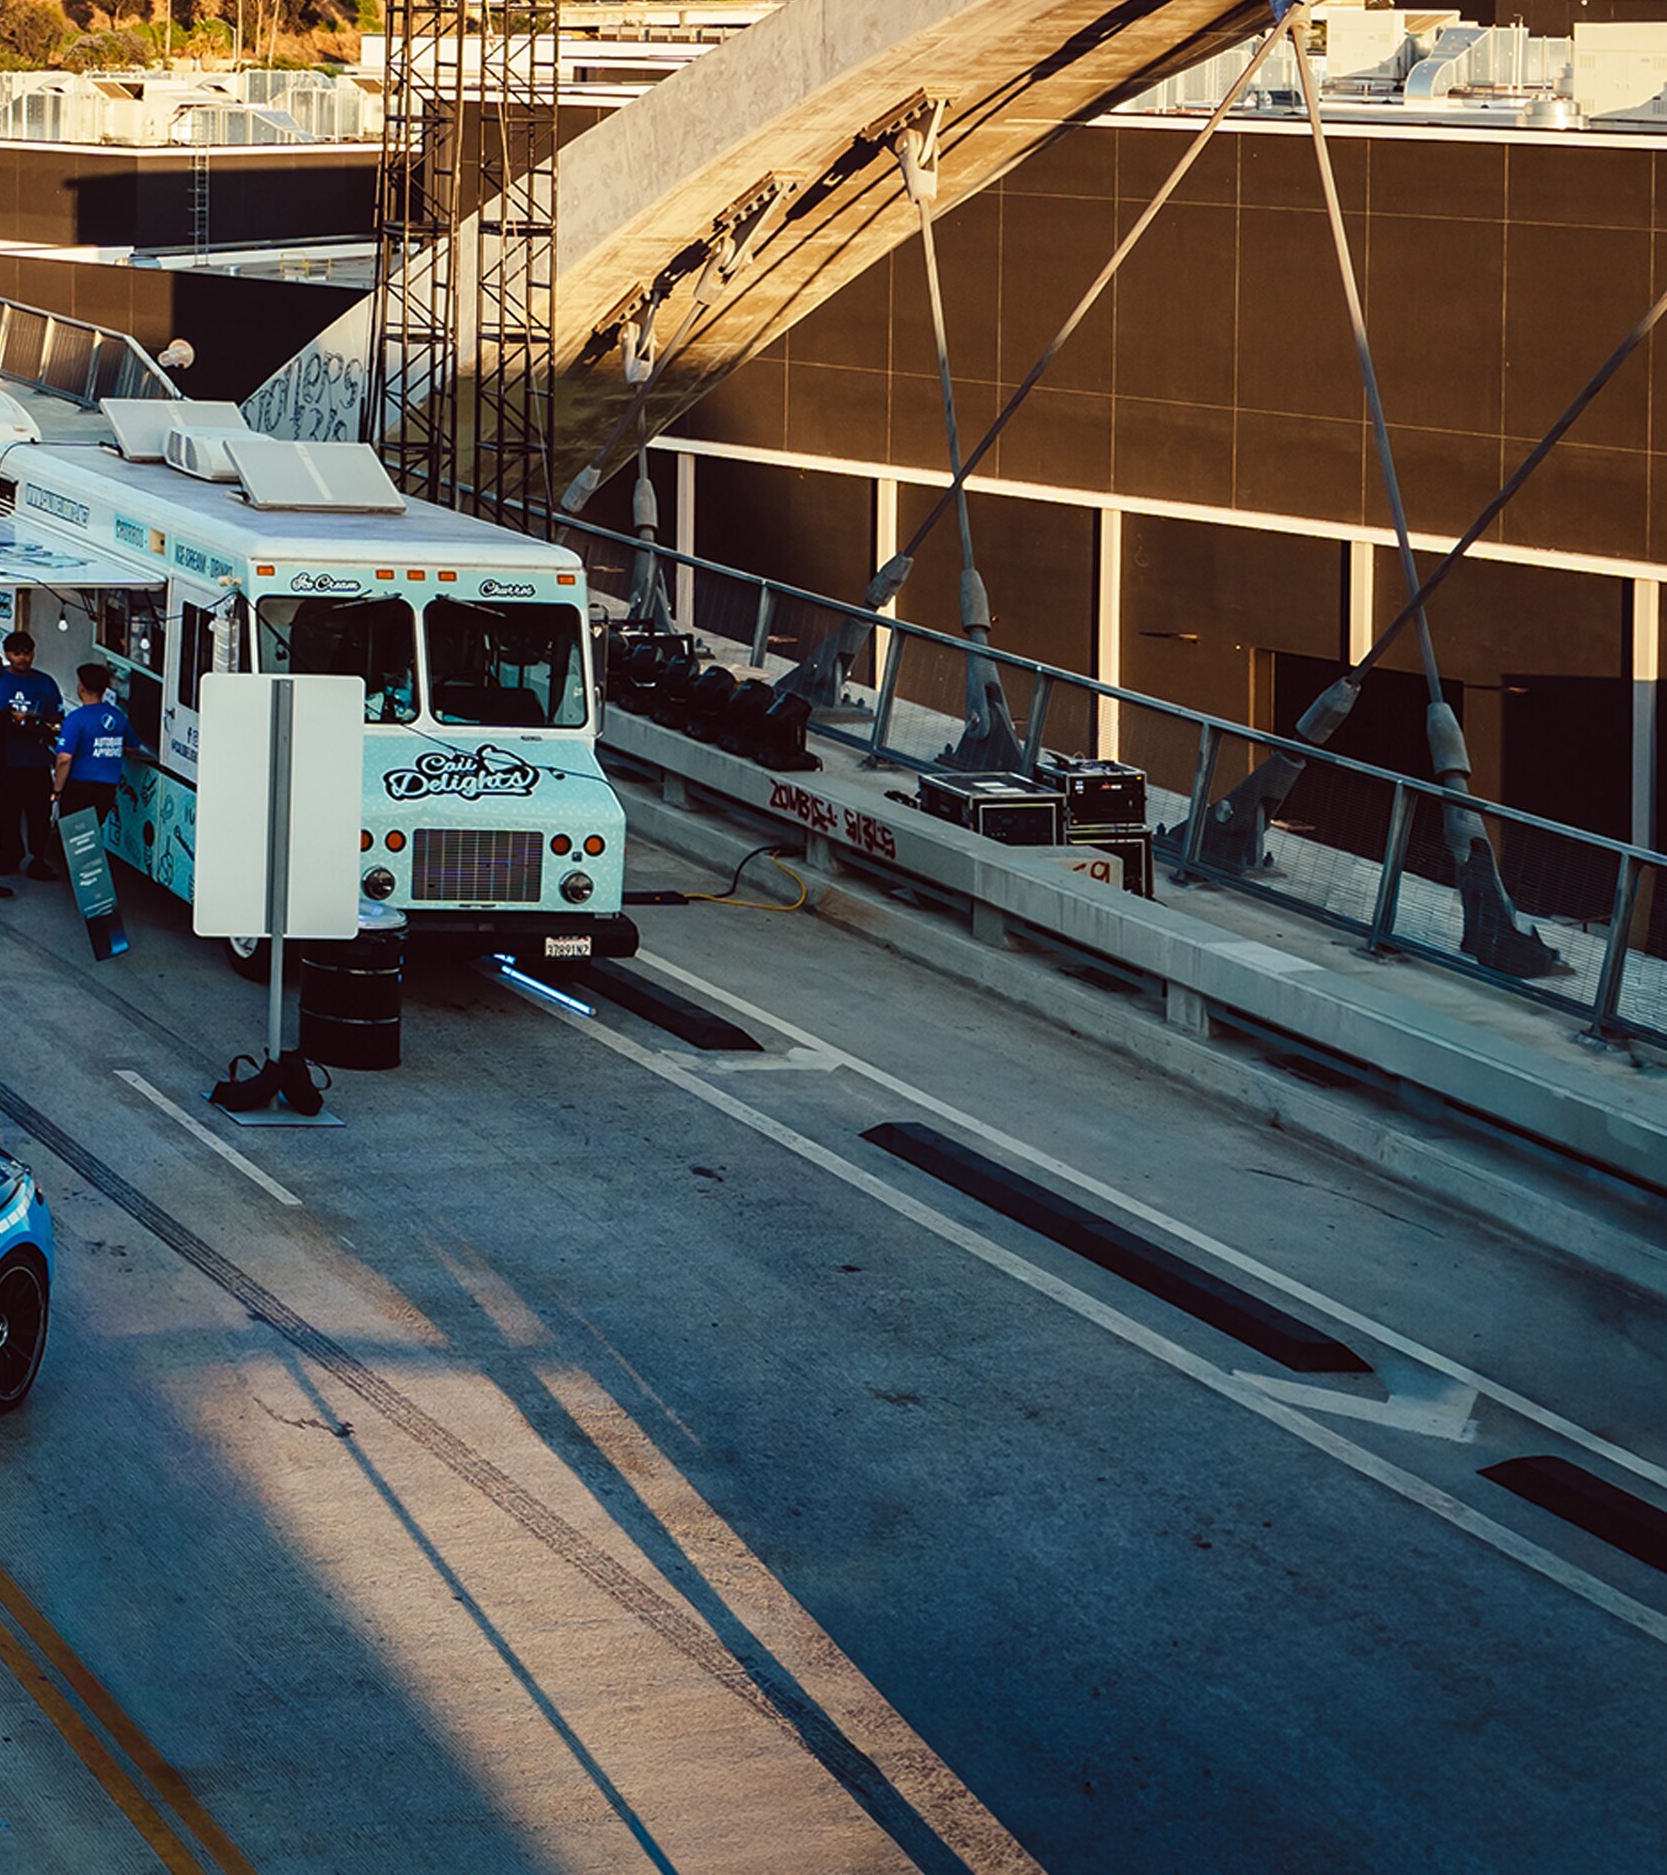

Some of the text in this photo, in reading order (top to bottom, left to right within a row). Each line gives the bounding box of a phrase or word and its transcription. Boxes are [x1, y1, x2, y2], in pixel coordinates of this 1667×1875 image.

[314, 573, 360, 591] Cream
[420, 755, 478, 775] Cali
[388, 766, 535, 798] Delights
